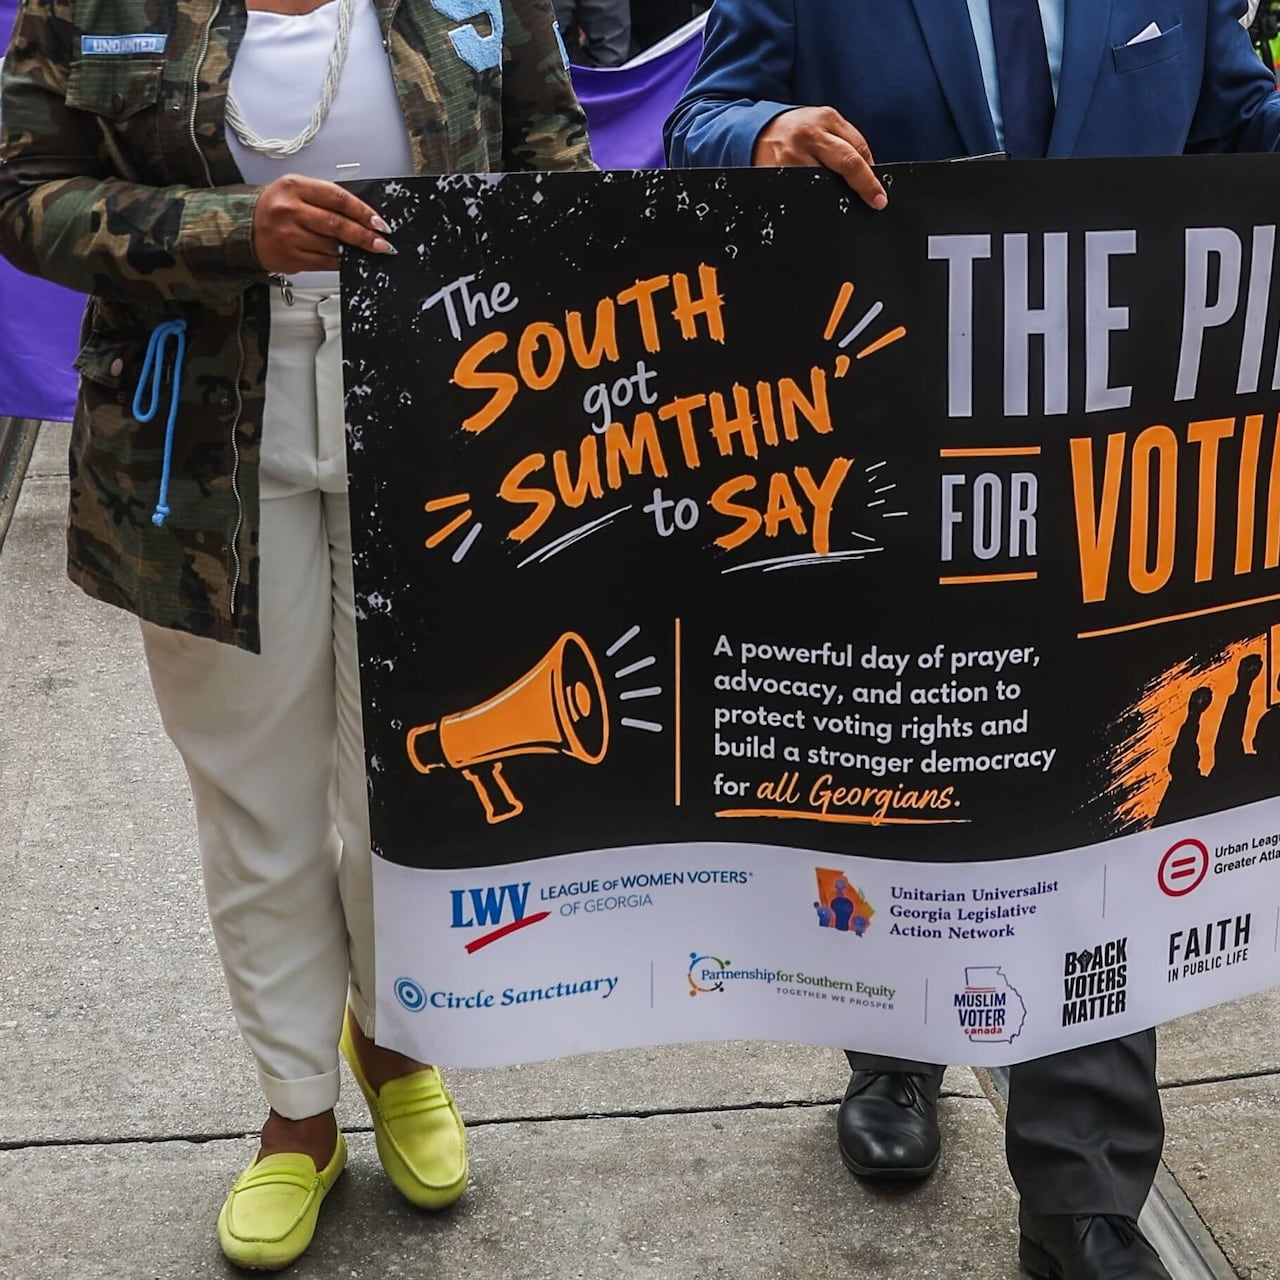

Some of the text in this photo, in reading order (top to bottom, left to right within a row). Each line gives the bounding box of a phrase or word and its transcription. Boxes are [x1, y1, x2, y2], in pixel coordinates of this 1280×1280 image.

[422, 274, 519, 341] The
[927, 229, 1138, 418] THE
[450, 263, 727, 434] SOUTH
[583, 361, 658, 433] got
[643, 457, 855, 556] to SAY
[939, 471, 1039, 562] FOR
[713, 634, 1041, 676] A powerful day of prayer,
[713, 669, 1021, 705] advocacy, and action to
[714, 706, 1029, 745] protect voting rights and
[714, 733, 1057, 777] build a stronger democracy
[714, 771, 962, 817] for all Georgians.
[1214, 840, 1249, 859] Urban
[1214, 855, 1257, 875] Greater
[449, 882, 531, 928] LWV
[540, 879, 599, 900] LEAGUE
[620, 872, 684, 890] WOMEN
[560, 894, 653, 917] OF GEORGIA
[890, 880, 1059, 902] Unitarian Universalist
[889, 902, 1037, 923] Georgia Legislative
[889, 922, 1015, 940] Action Network
[1064, 937, 1128, 976] BACK
[1169, 913, 1251, 965] FAITH
[776, 969, 794, 985] for
[796, 972, 853, 992] Southern
[856, 979, 896, 999] Equity
[1063, 965, 1127, 1001] VOTERS
[1168, 948, 1249, 983] IN PUBLIC LIFE
[430, 975, 619, 1010] Circle Sanctuary
[776, 987, 894, 1011] TOGETHER WE PROSPER
[954, 992, 1006, 1007] MUSLIM
[1062, 990, 1126, 1027] MATTER
